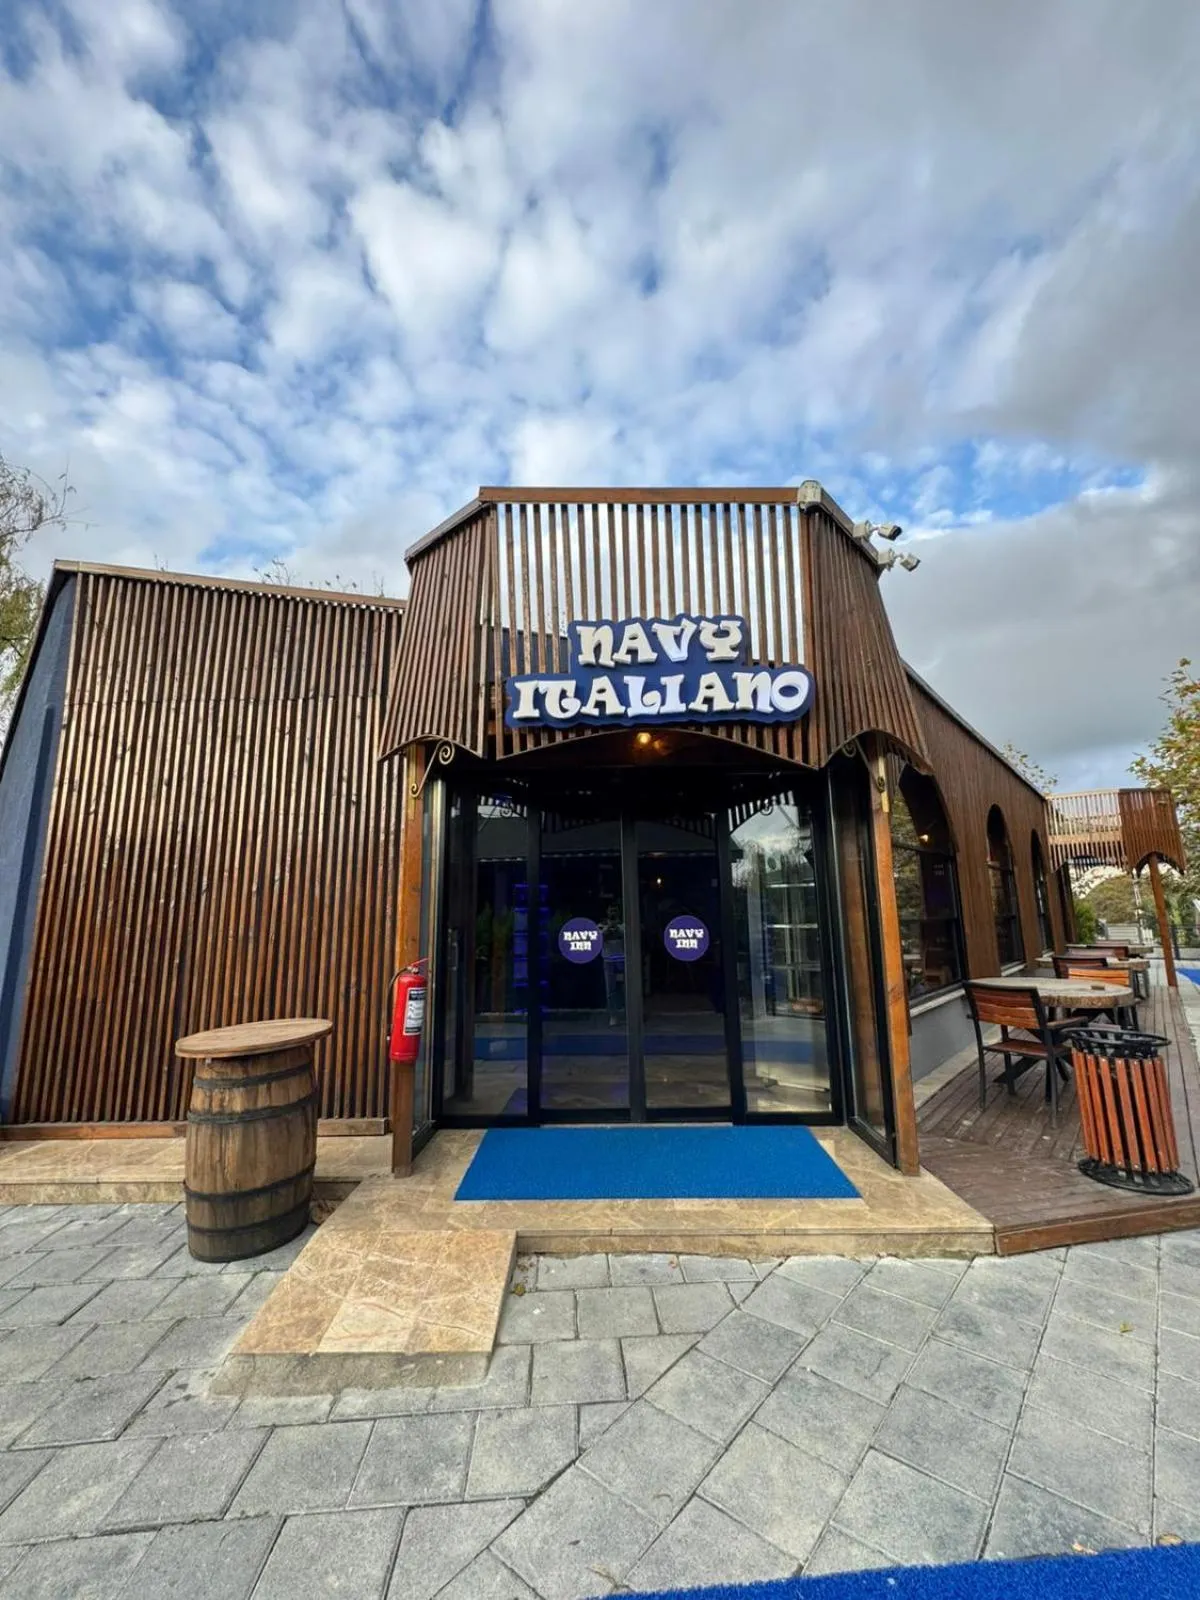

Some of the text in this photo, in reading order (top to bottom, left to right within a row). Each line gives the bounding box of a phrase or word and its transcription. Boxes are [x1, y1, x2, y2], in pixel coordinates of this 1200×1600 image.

[576, 618, 742, 667] NAVY
[513, 671, 810, 718] ITALIANO
[563, 930, 598, 941] NAVY
[669, 928, 704, 939] NAVY
